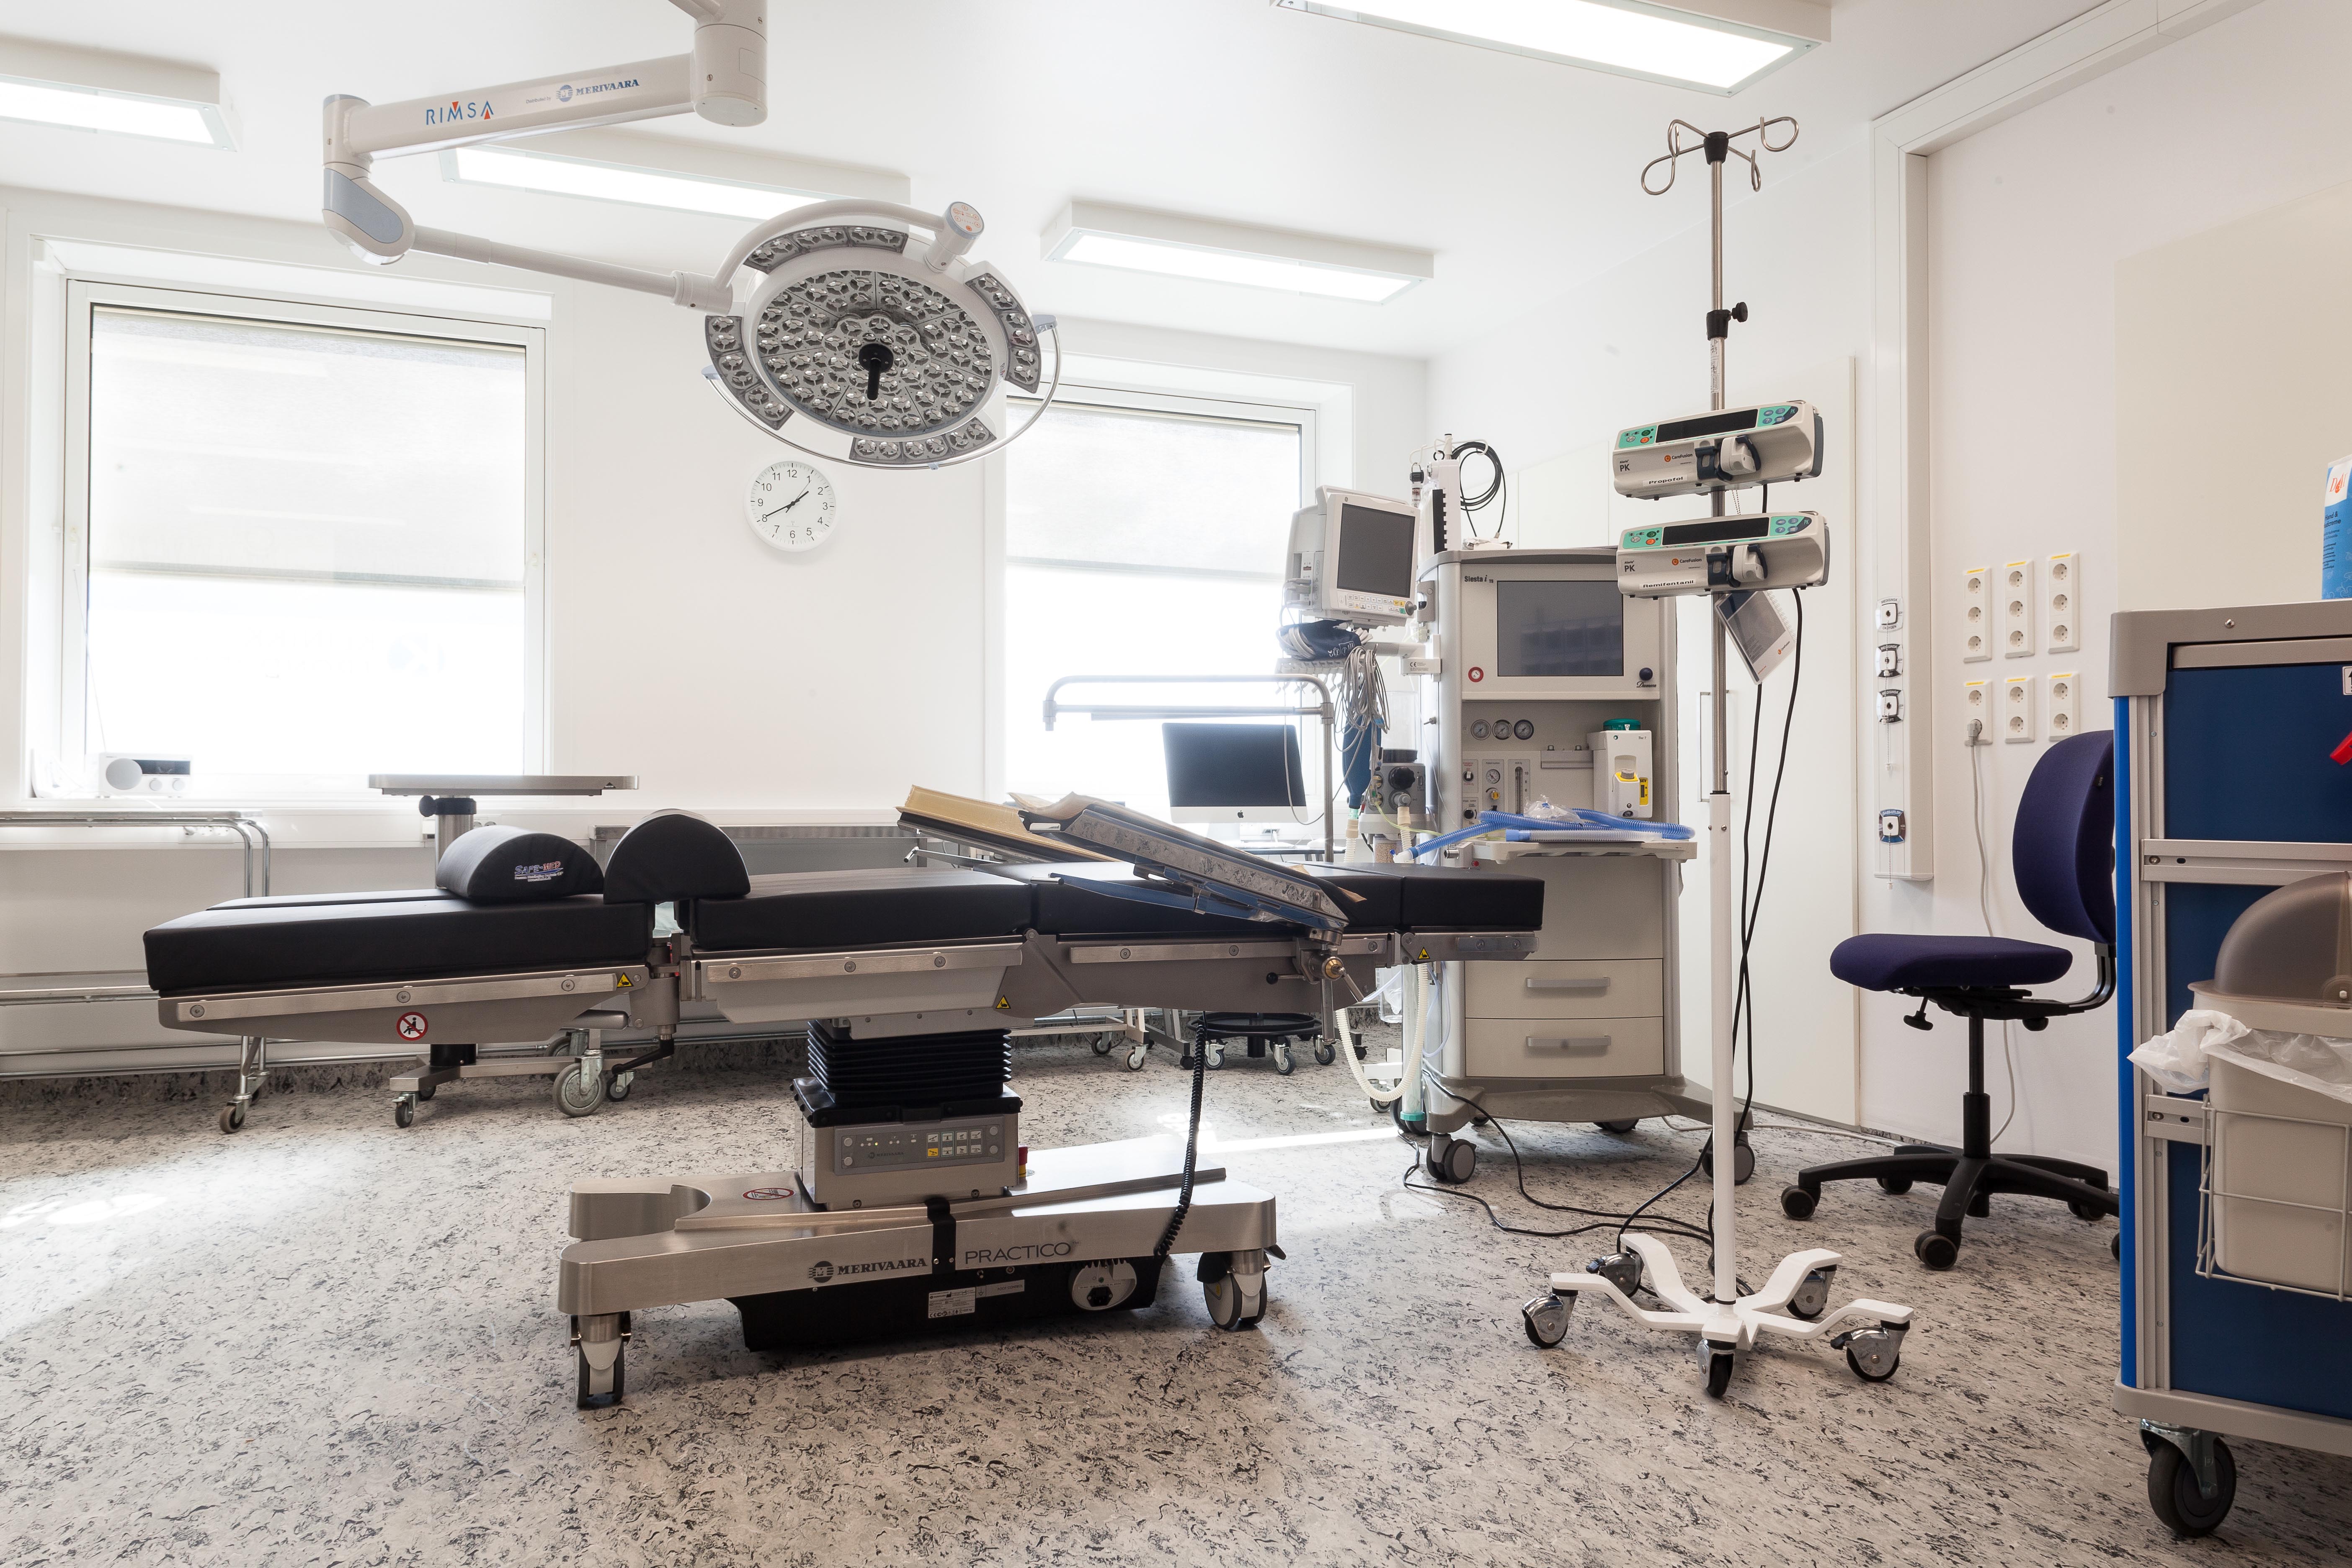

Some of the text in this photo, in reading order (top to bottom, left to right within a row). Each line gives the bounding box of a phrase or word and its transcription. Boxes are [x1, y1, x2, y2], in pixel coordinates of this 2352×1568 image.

[576, 79, 640, 96] MERIVAARA
[426, 101, 494, 125] RIMSA
[787, 469, 797, 478] 12
[515, 861, 561, 875] SAFE-MED
[837, 1258, 927, 1275] MERIVAARA
